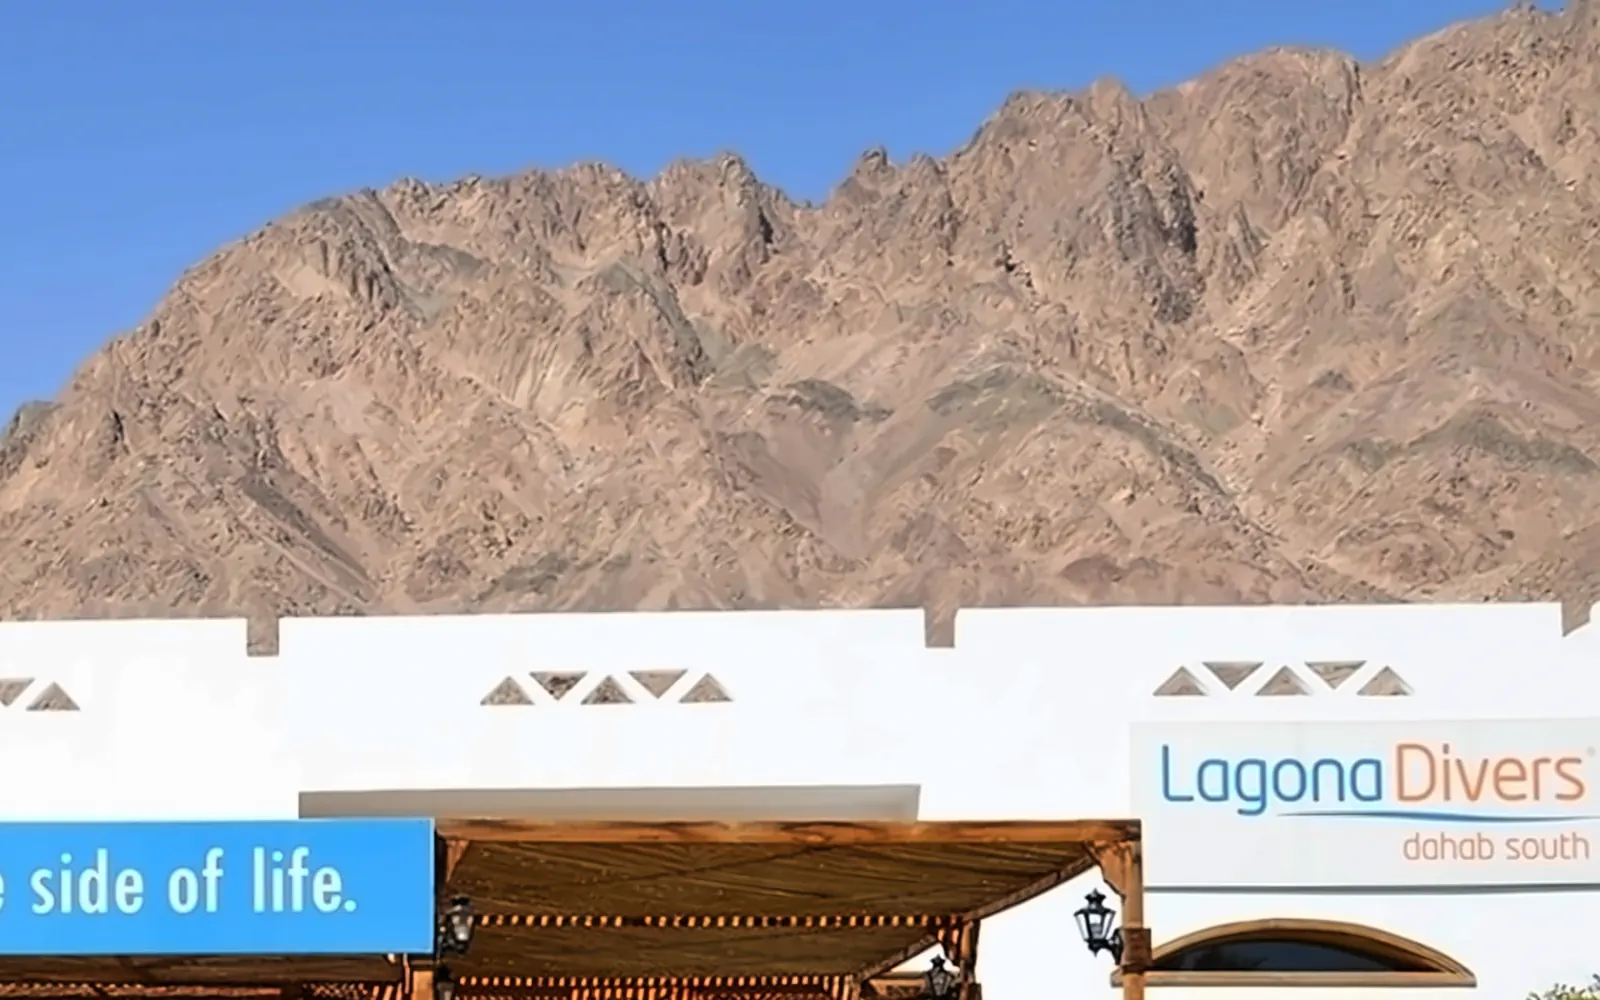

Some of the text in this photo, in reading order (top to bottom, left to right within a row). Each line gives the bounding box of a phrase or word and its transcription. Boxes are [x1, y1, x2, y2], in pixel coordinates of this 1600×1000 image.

[1161, 743, 1585, 817] Lagona Divers
[30, 848, 144, 914] side
[168, 847, 224, 914] of
[253, 846, 356, 913] life.
[1403, 831, 1590, 861] dahab south
